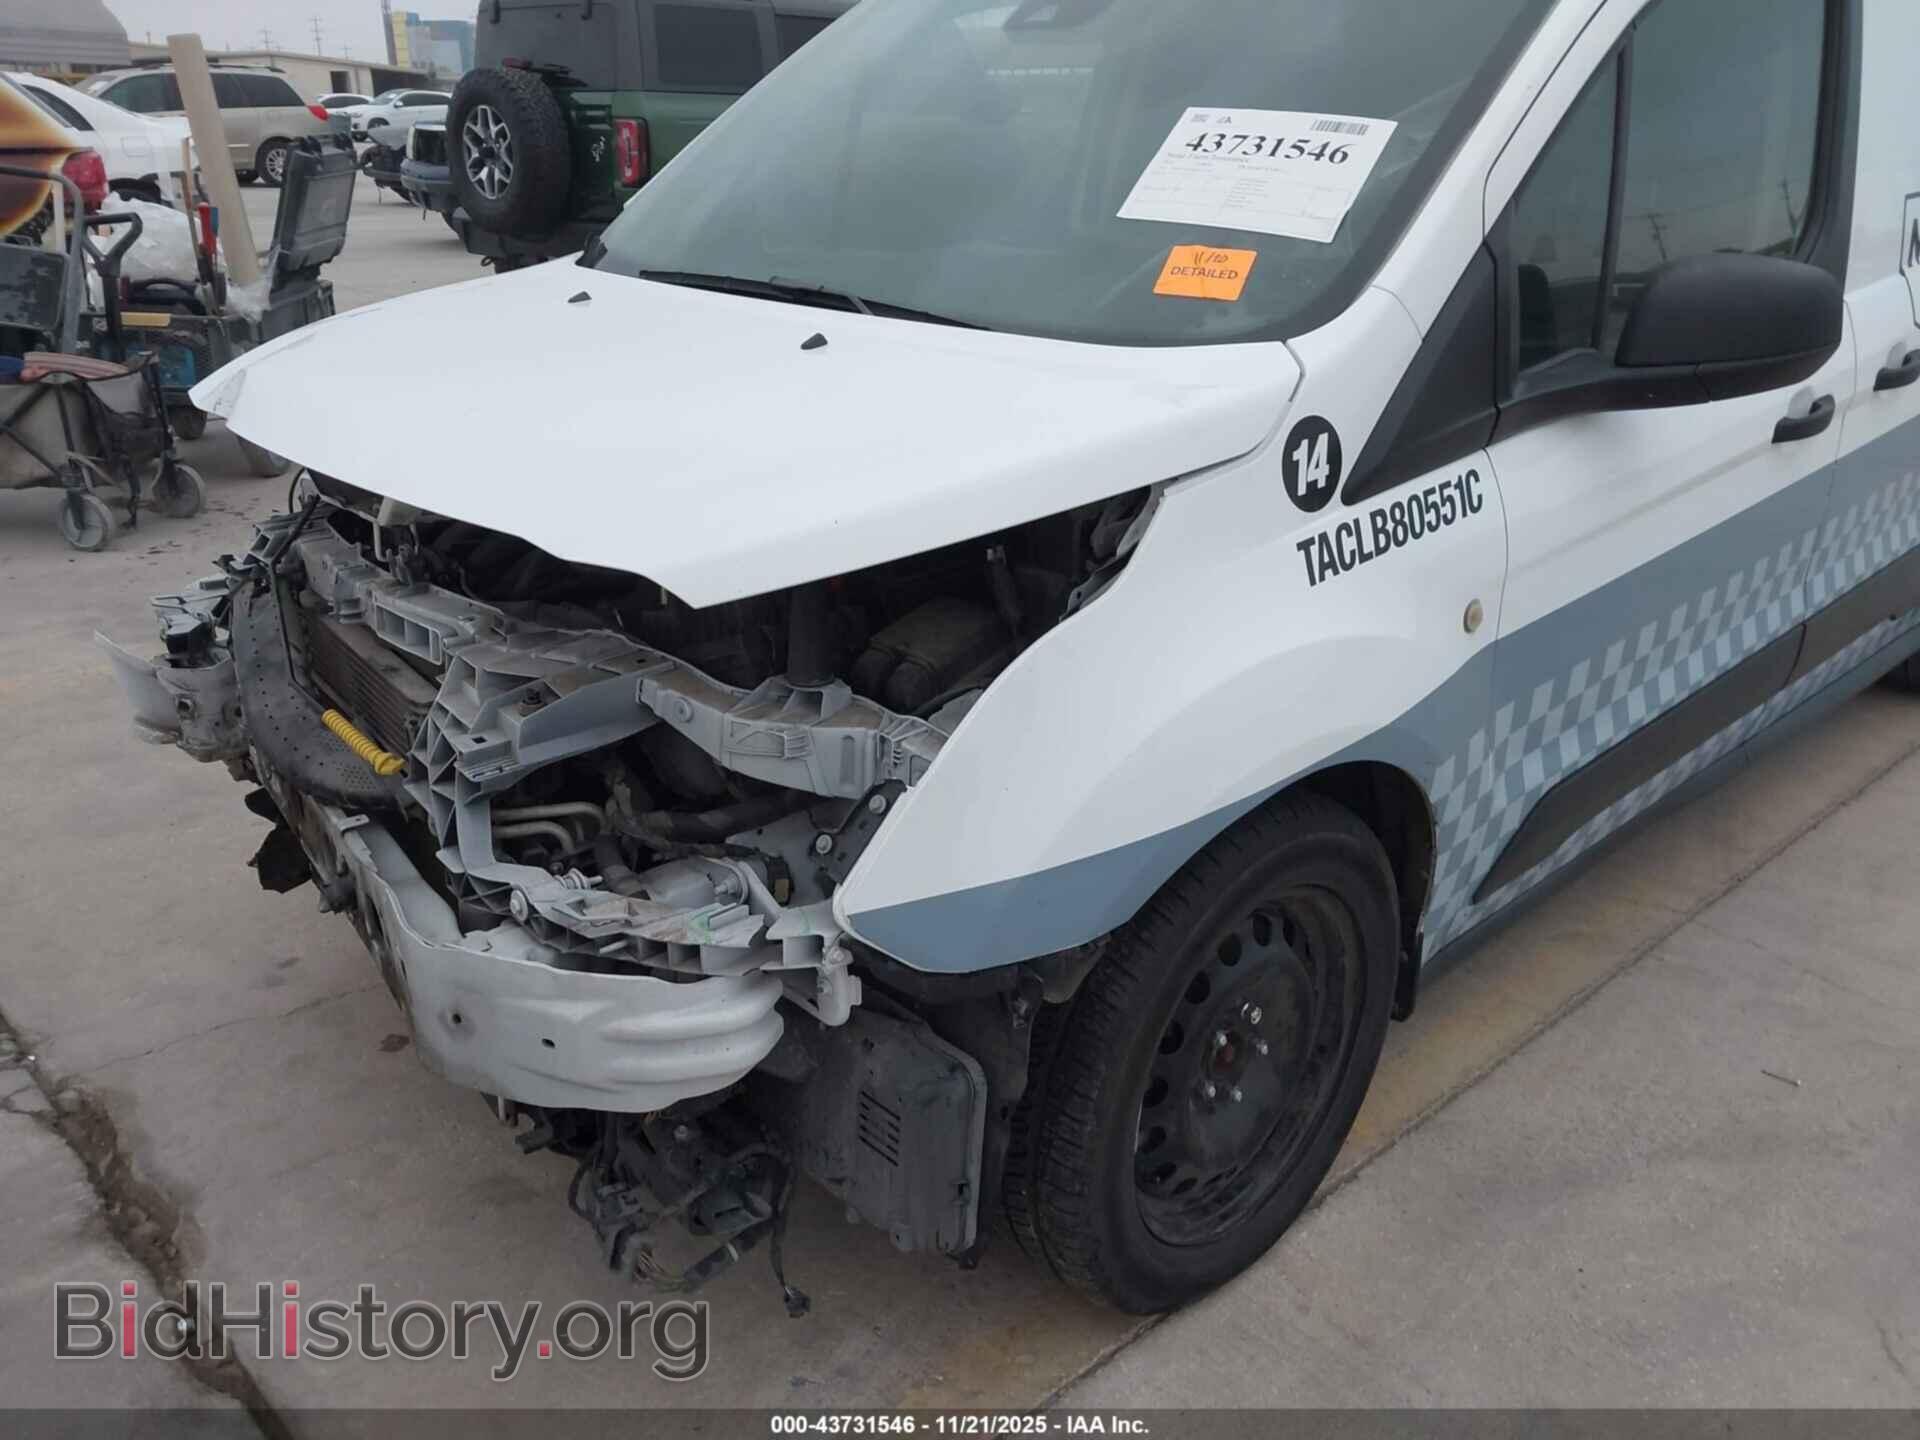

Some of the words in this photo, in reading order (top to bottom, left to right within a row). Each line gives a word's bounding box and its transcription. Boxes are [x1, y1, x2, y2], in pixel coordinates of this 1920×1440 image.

[1185, 131, 1357, 166] 43731546
[1170, 265, 1239, 280] DETAILED
[1292, 432, 1330, 497] 14
[1296, 468, 1483, 587] TACLB80551C
